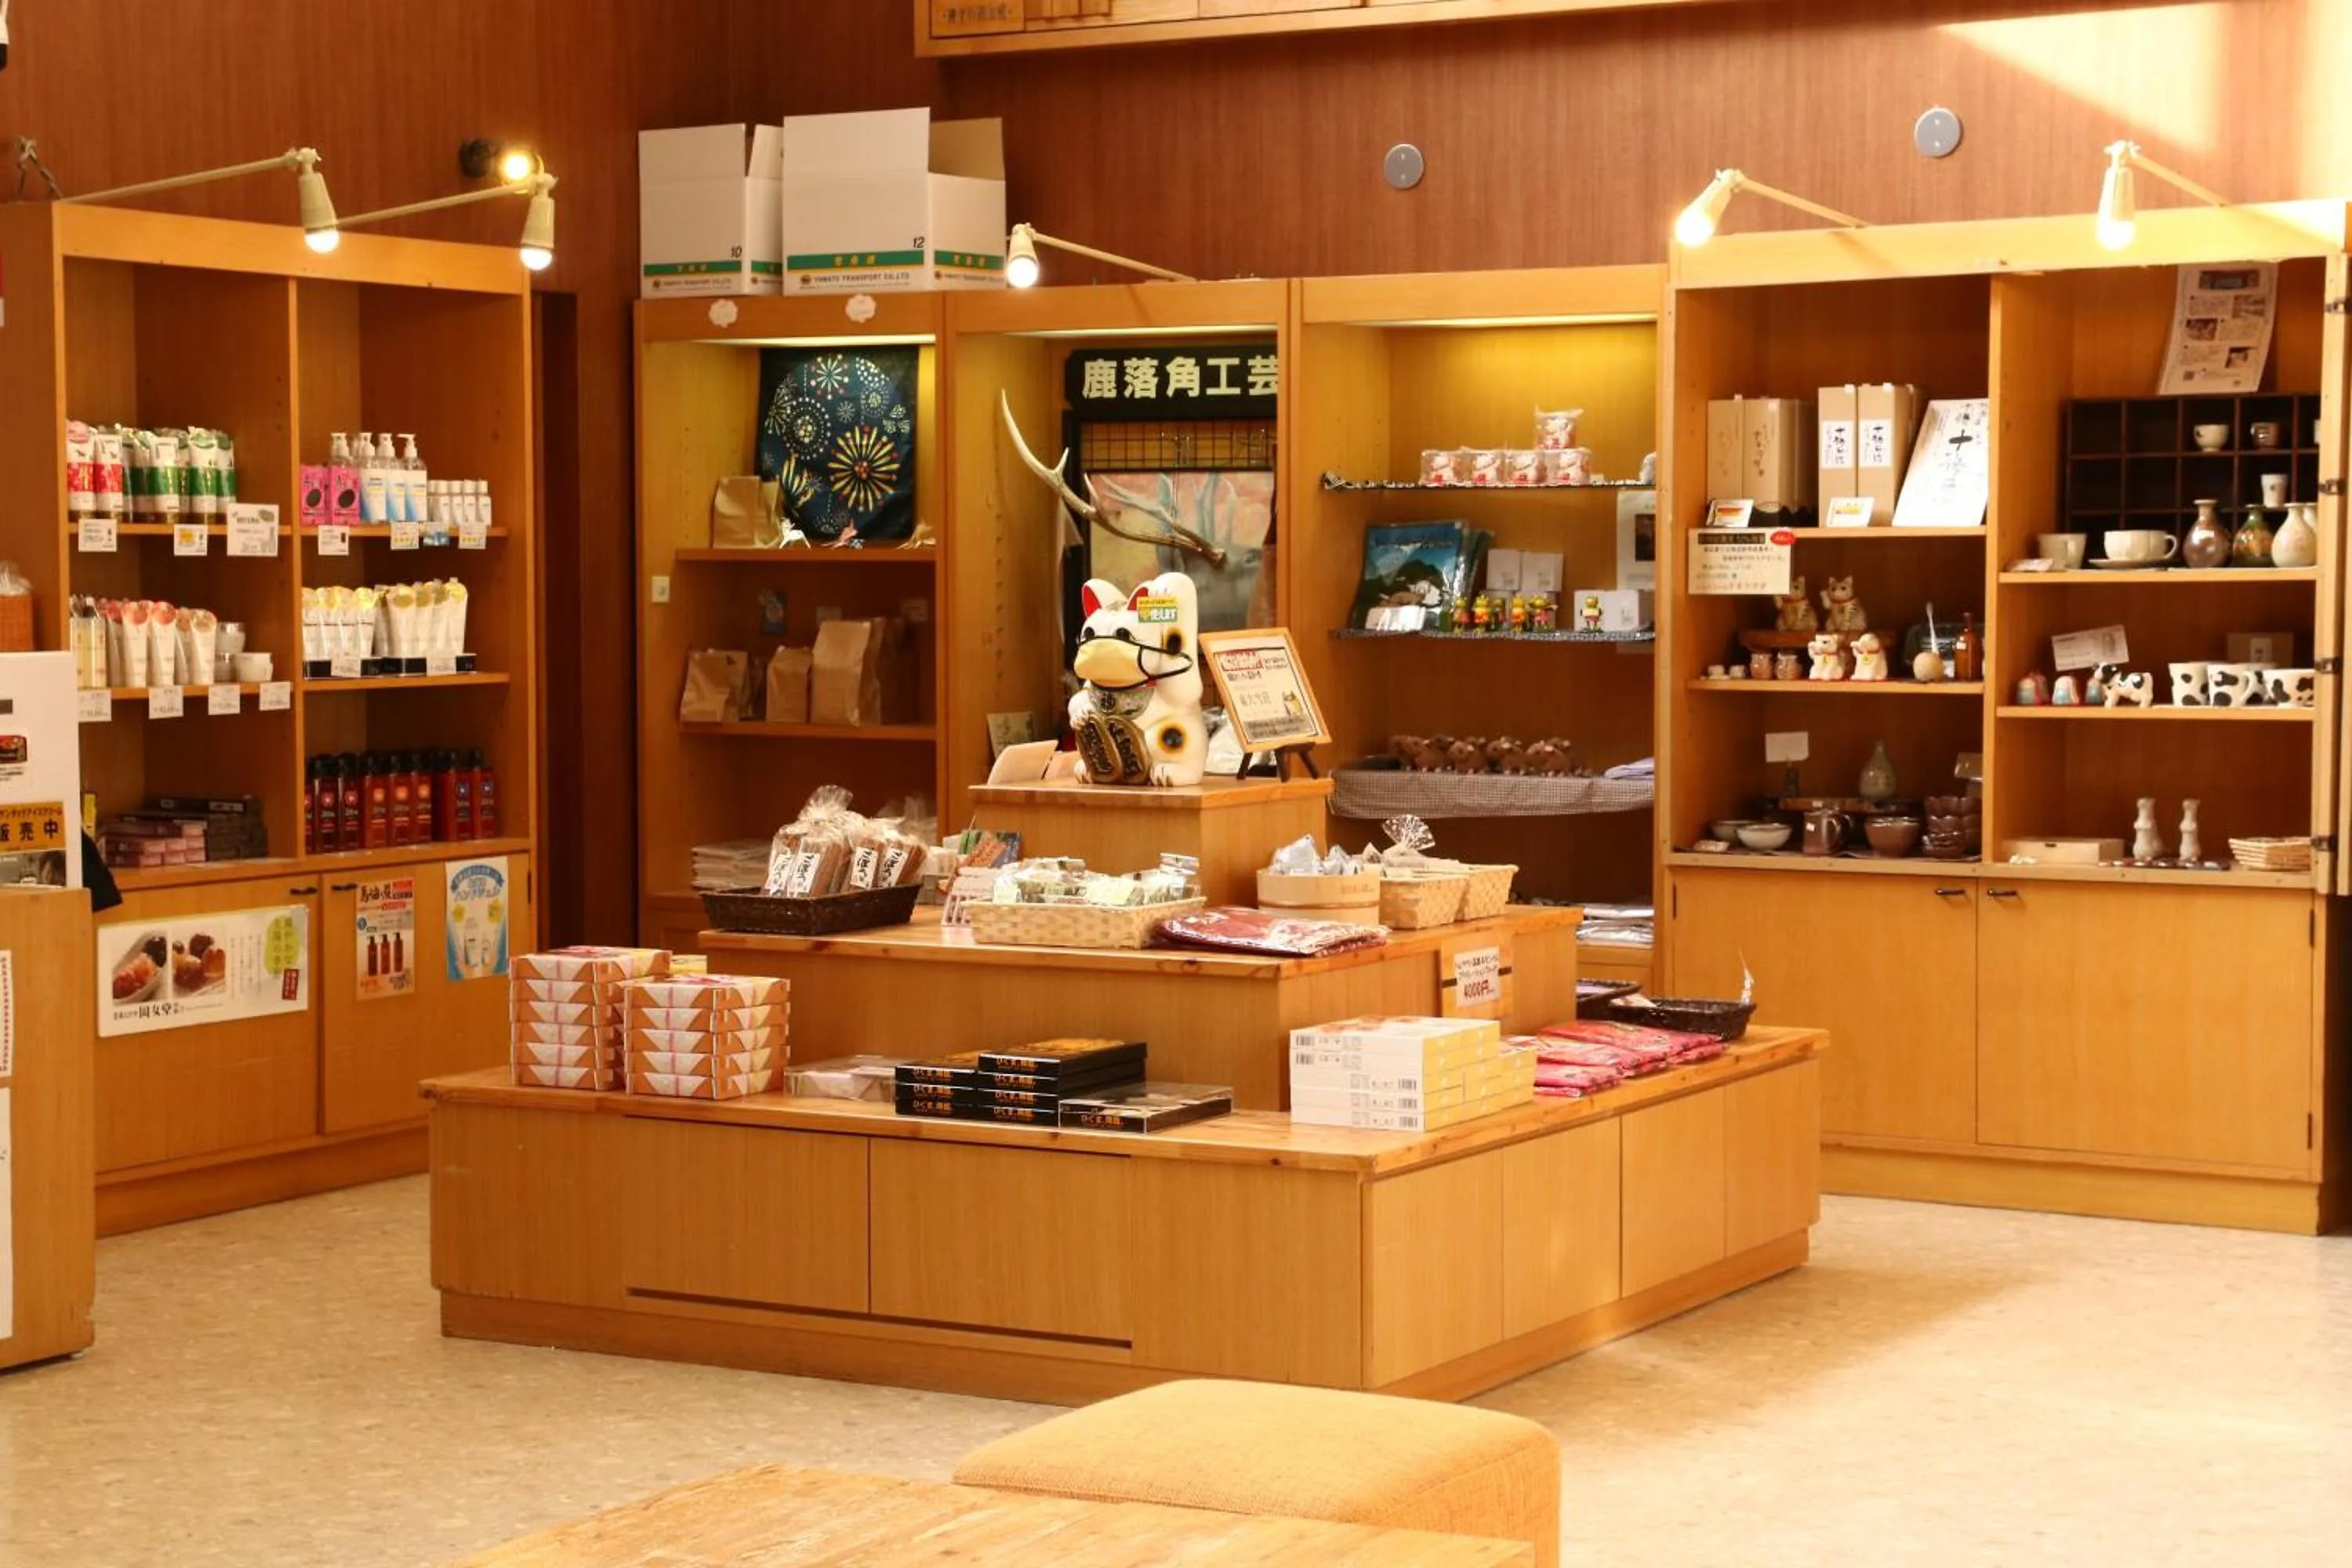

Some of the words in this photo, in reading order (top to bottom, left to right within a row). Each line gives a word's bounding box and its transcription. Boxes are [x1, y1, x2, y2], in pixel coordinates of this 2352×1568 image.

[913, 236, 925, 249] 12
[731, 245, 742, 259] 10
[1082, 355, 1278, 398] 鹿落角工芸
